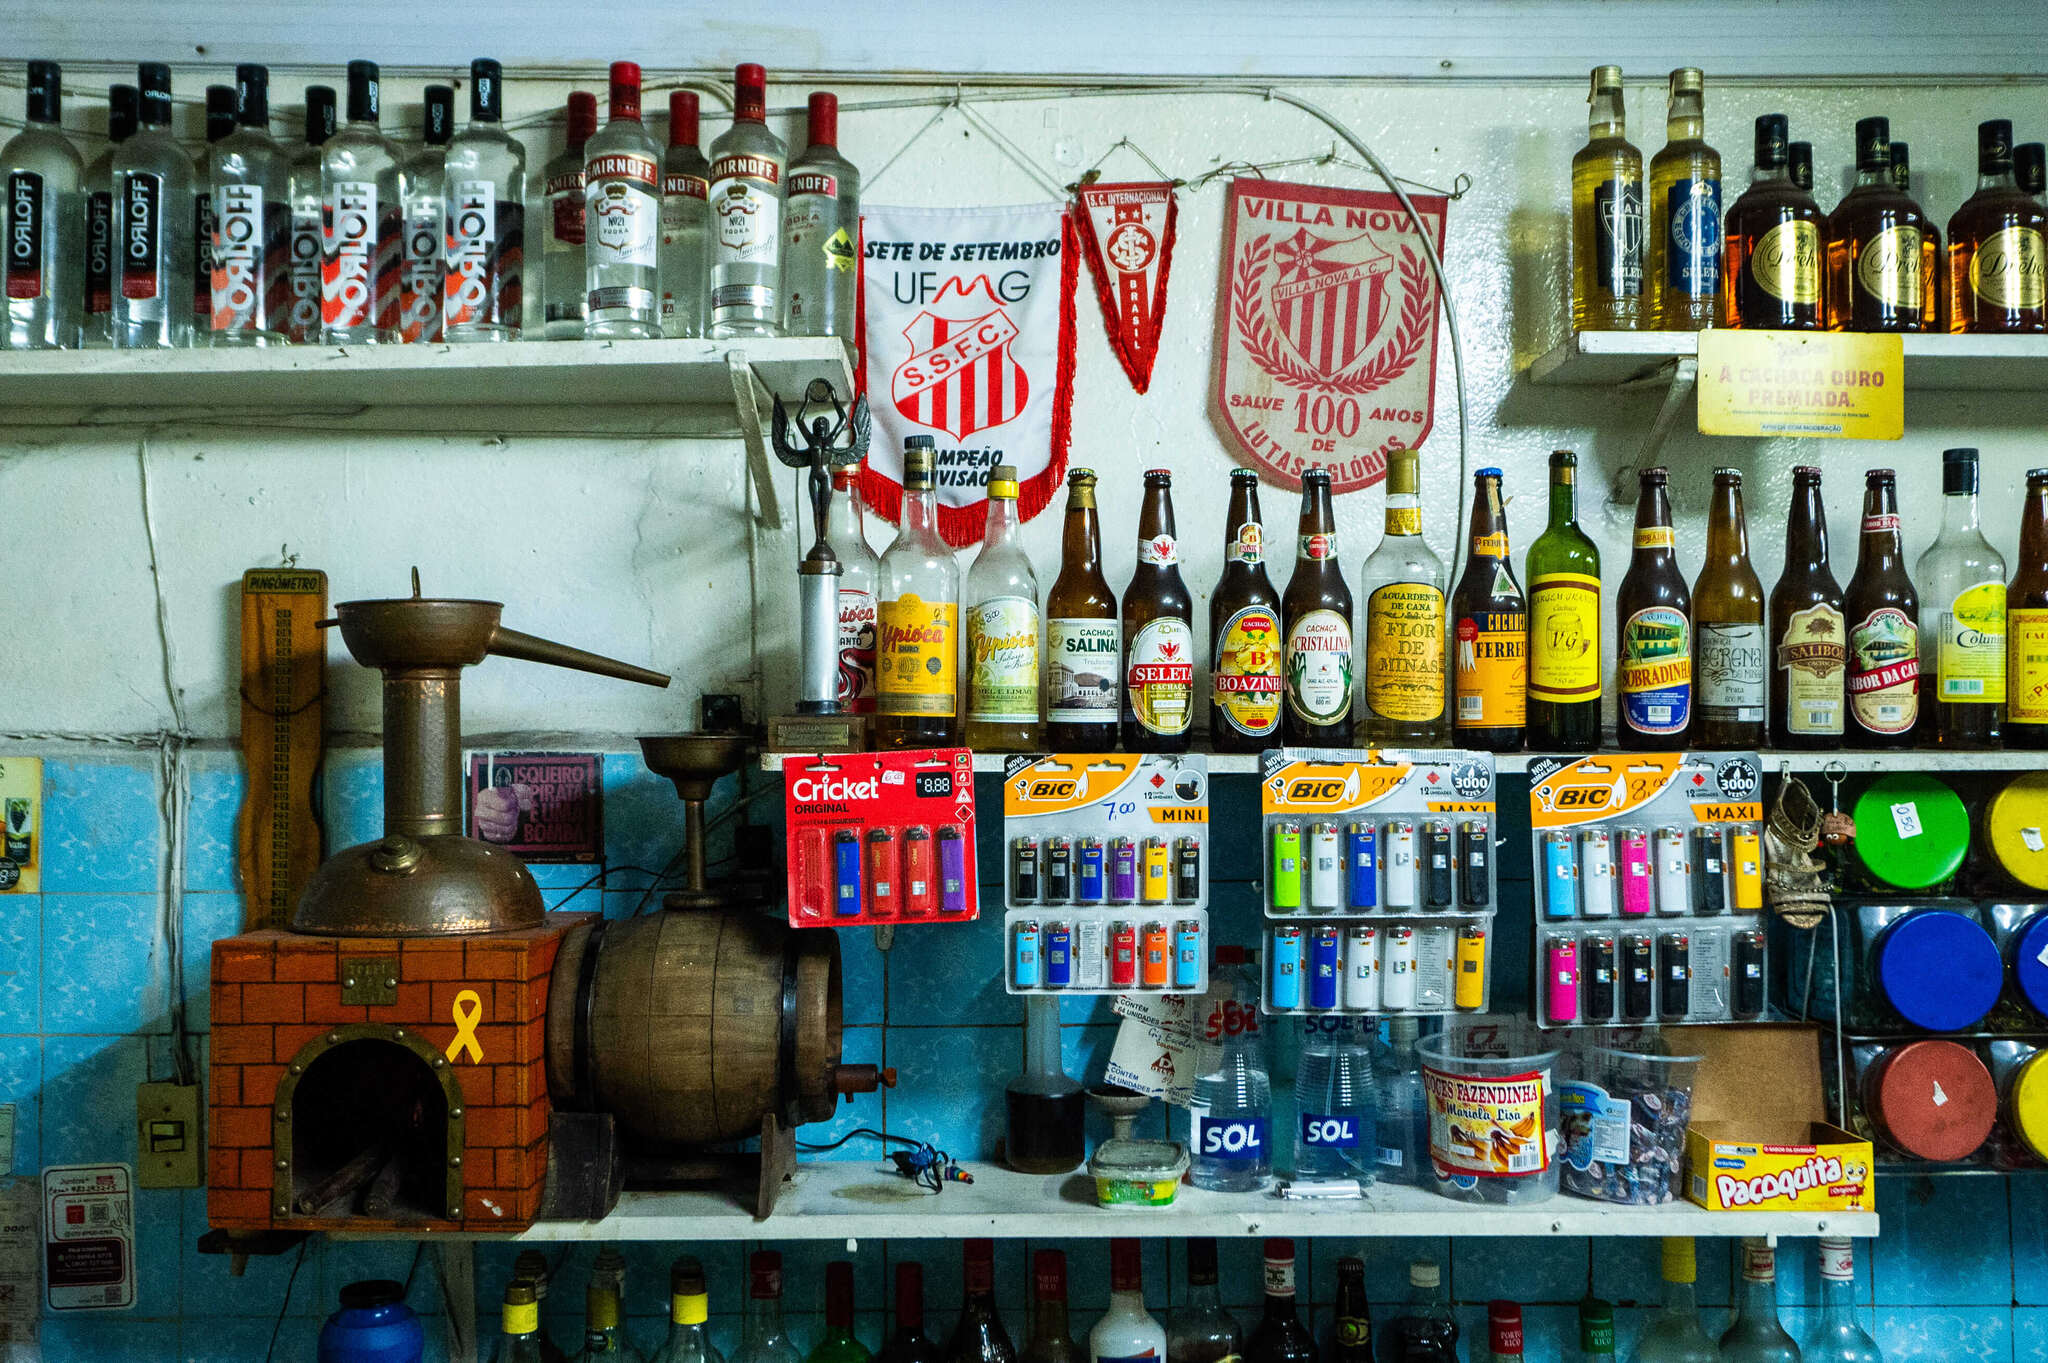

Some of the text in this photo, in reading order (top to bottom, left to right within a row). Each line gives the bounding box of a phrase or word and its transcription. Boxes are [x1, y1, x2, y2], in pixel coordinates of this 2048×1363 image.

[586, 158, 653, 181] SMIRNOFF
[711, 157, 774, 179] SMIRNOFF
[1108, 191, 1166, 204] INTERNACIONAL
[14, 178, 34, 258] ORLOFF
[129, 178, 150, 258] ORLOFF
[1244, 198, 1434, 237] VILLA NOVA
[339, 182, 368, 308] ORLOFF
[461, 183, 486, 306] ORLOFF
[864, 239, 1062, 261] SETE DE SETEMBRO
[894, 270, 1031, 306] UFMG
[1276, 281, 1311, 299] VILLA
[1314, 271, 1349, 289] NOVA
[1832, 370, 1885, 387] OURO
[1230, 394, 1285, 411] SALVE
[1749, 390, 1856, 408] PREMIADA.
[1294, 392, 1361, 438] 100
[1369, 407, 1423, 423] ANOS
[1242, 421, 1307, 476] LUTAS
[1311, 439, 1335, 452] DE
[937, 445, 1003, 466] MPEÃO
[1382, 592, 1439, 601] AGUARDENTE
[1406, 603, 1431, 611] CANA
[1080, 629, 1114, 637] CACHAÇA
[1306, 625, 1337, 633] CACHAÇA
[1385, 622, 1436, 637] FLOR
[880, 623, 945, 653] Ypióca
[1398, 640, 1424, 655] DE
[1251, 652, 1266, 665] B
[1379, 658, 1438, 673] MINAS
[1219, 676, 1280, 691] BOAZINH
[1883, 669, 1899, 683] DA
[1007, 755, 1025, 770] NOVA
[1531, 758, 1553, 774] NOVA
[513, 766, 585, 783] ISQUEIRO
[793, 773, 879, 801] Cricket
[924, 777, 950, 792] 8.88
[1455, 778, 1487, 788] 3000
[1720, 778, 1753, 791] 3000
[1144, 792, 1152, 800] 12
[1420, 787, 1429, 796] 12
[794, 804, 849, 814] ORIGINAL
[1163, 808, 1202, 822] MINI
[1707, 806, 1755, 820] MAXI
[1457, 1083, 1538, 1105] FAZENDINHA
[1446, 1101, 1491, 1121] Mariola
[1204, 1123, 1260, 1153] SOL
[1307, 1120, 1353, 1143] SOL
[1716, 1156, 1842, 1208] Paçoquita
[1504, 1339, 1521, 1347] RICO
